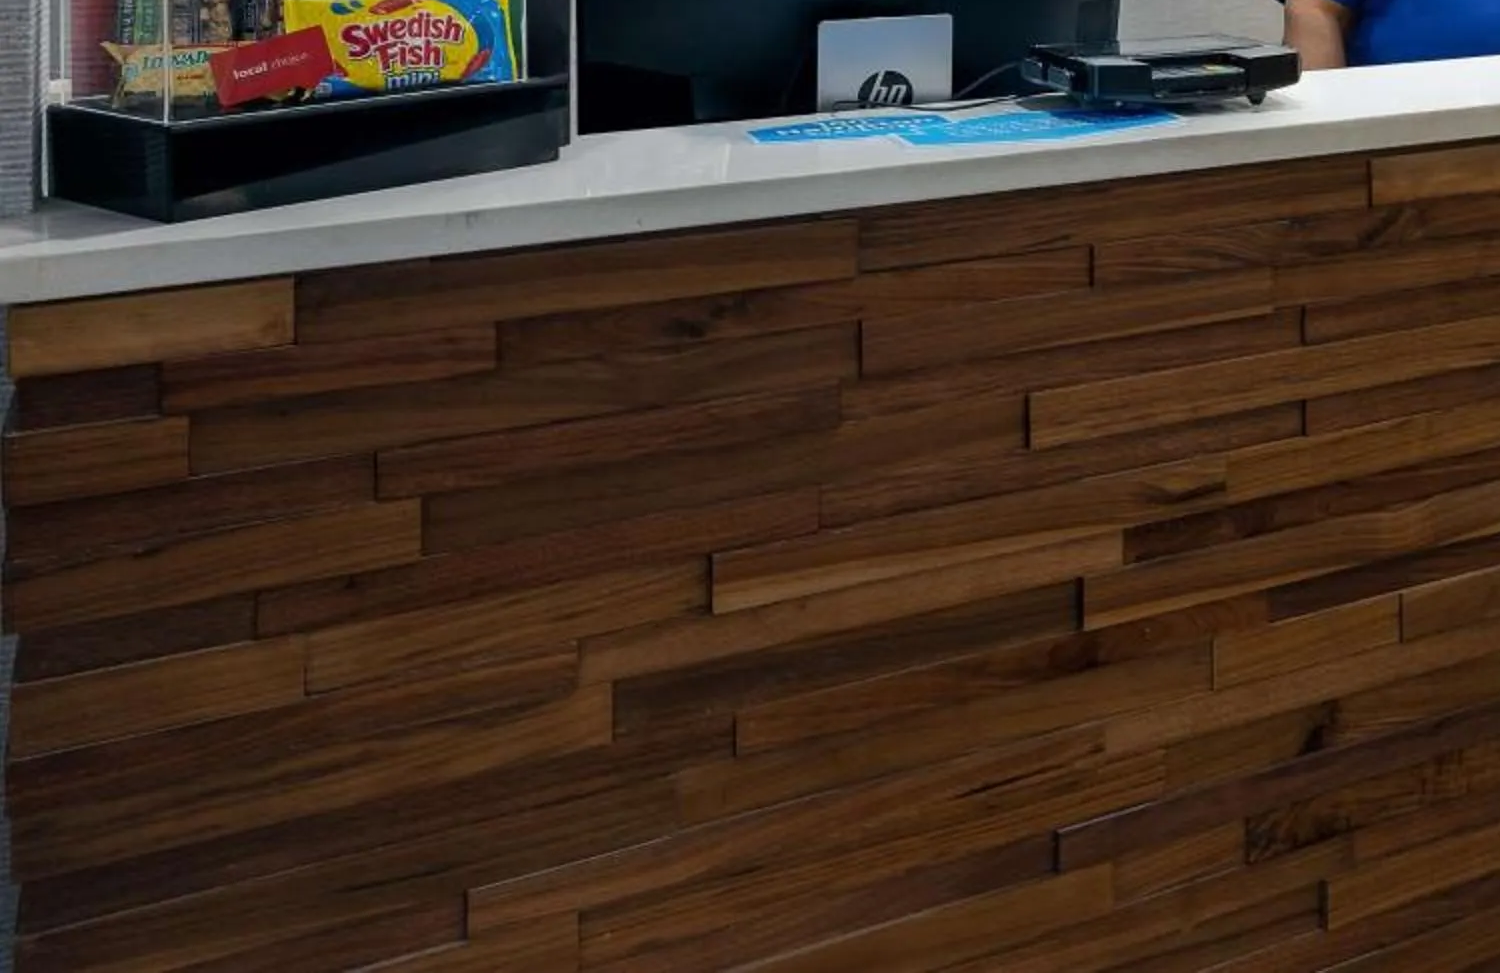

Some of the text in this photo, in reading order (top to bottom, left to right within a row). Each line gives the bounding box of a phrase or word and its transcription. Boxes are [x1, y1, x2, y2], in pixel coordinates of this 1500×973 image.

[341, 10, 464, 61] Swedish
[375, 38, 444, 74] Fish
[386, 71, 440, 90] mini
